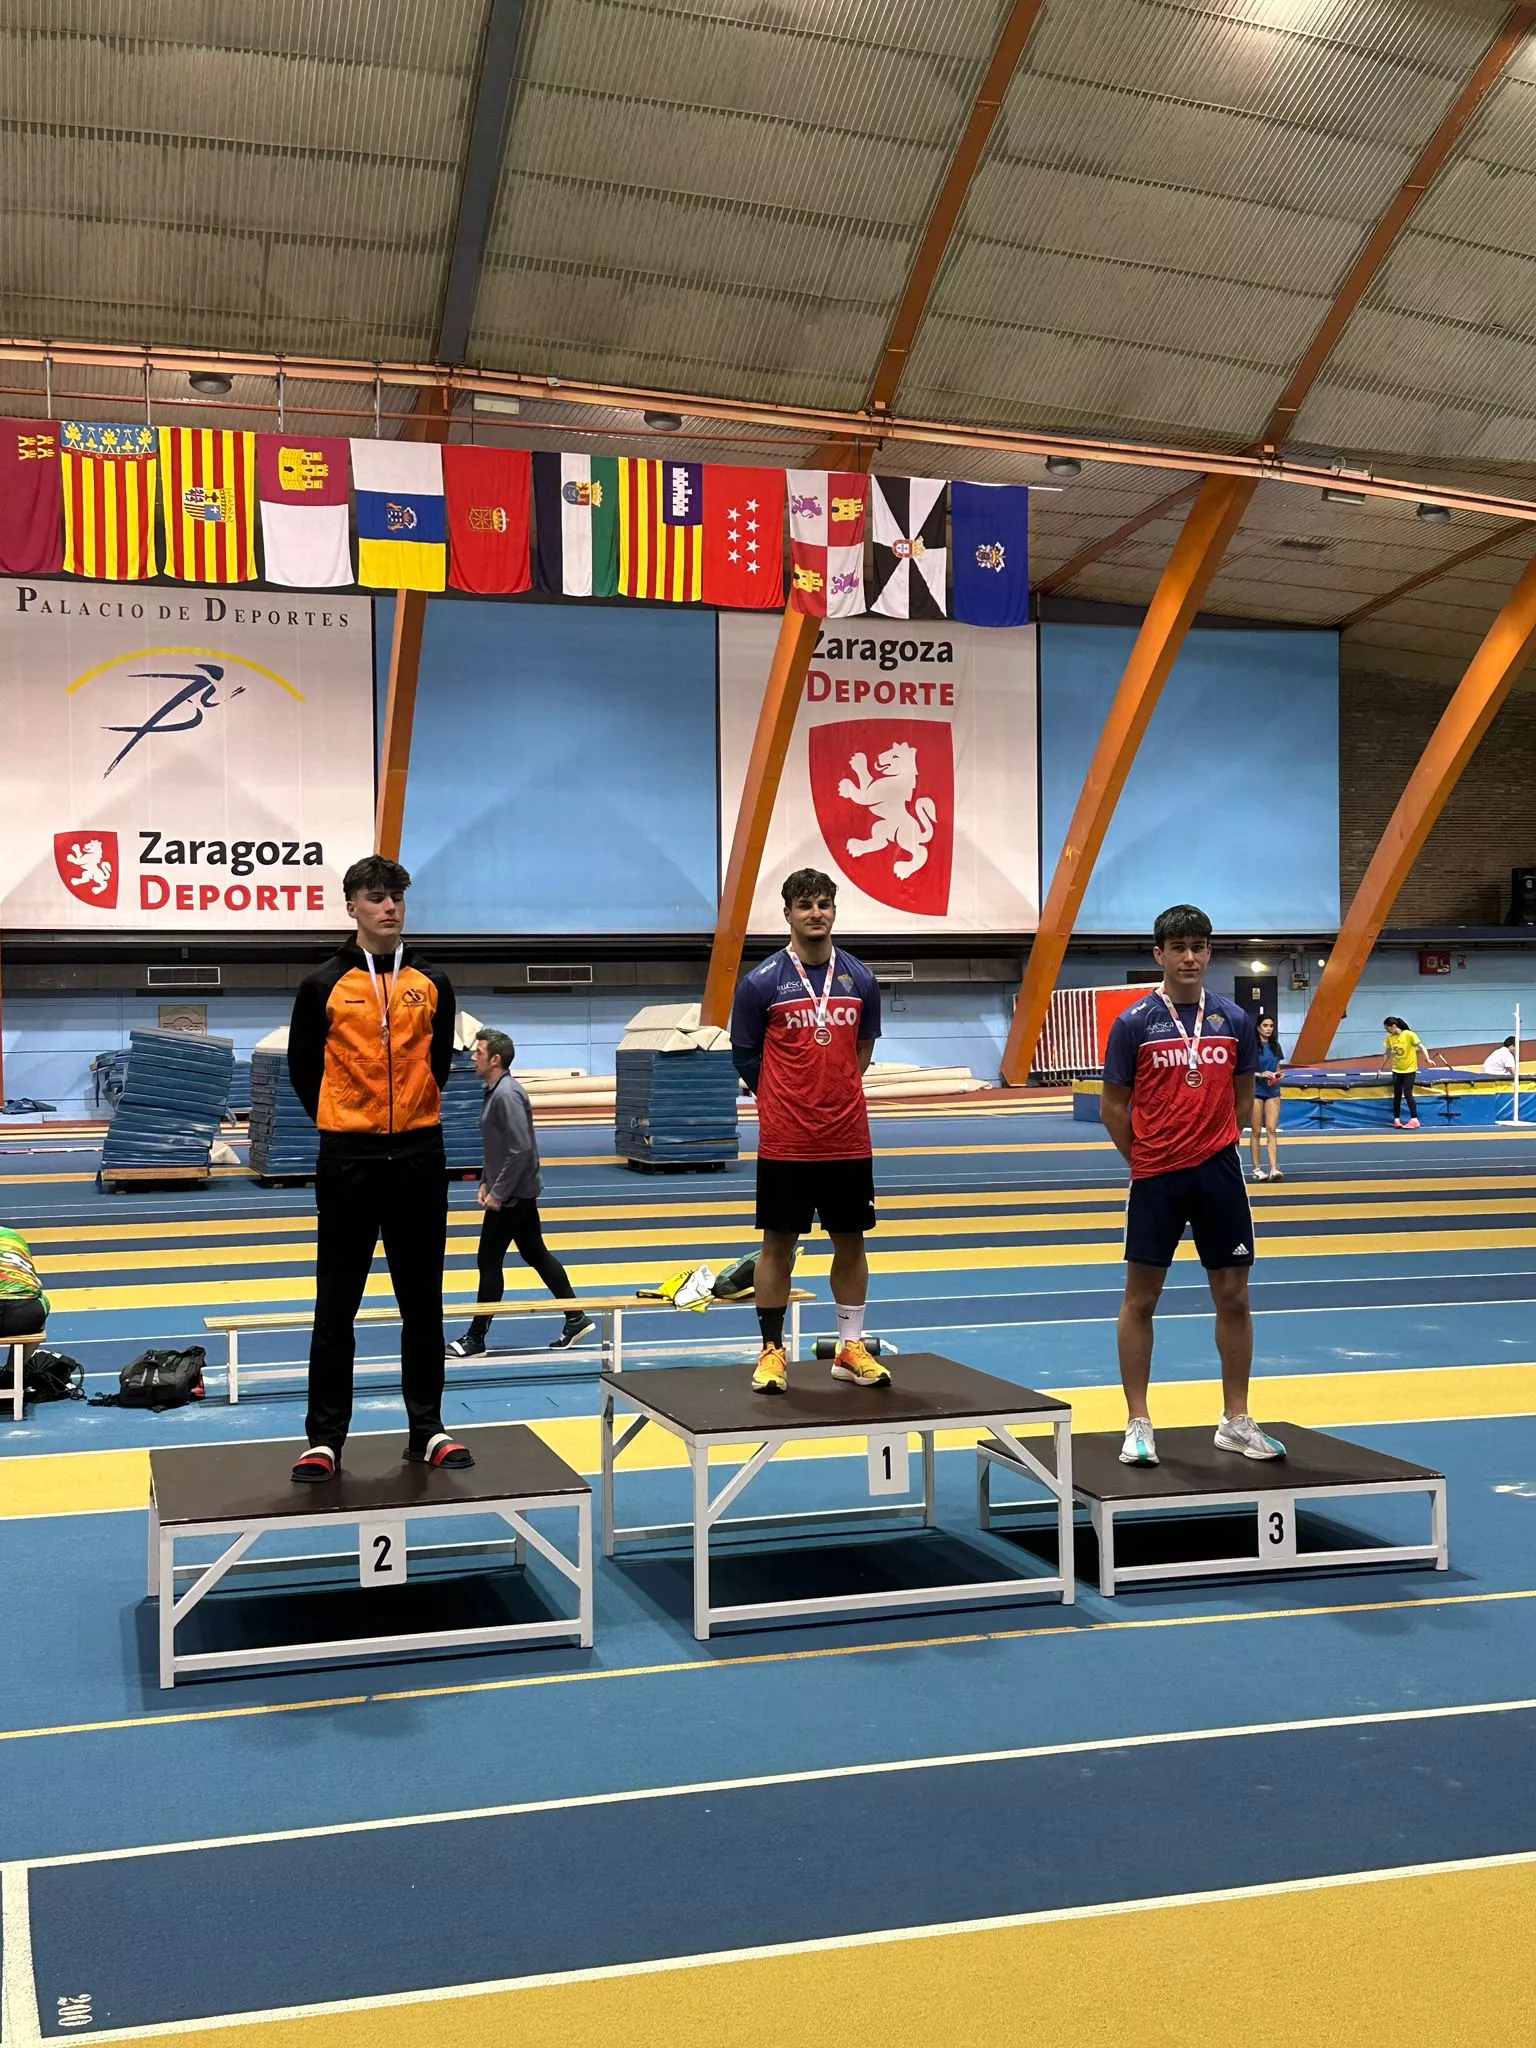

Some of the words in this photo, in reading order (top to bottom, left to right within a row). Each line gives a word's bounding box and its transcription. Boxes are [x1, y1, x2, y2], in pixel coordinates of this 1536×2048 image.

[16, 586, 144, 620] PALACIO
[159, 605, 190, 621] DE
[204, 597, 349, 628] DEPORTES
[807, 670, 954, 706] DEPORTE
[139, 831, 324, 877] Zaragoza
[139, 874, 325, 911] DEPORTE
[883, 1446, 891, 1480] 1
[1268, 1511, 1284, 1545] 3
[373, 1535, 392, 1573] 2
[57, 1993, 93, 2027] 200
